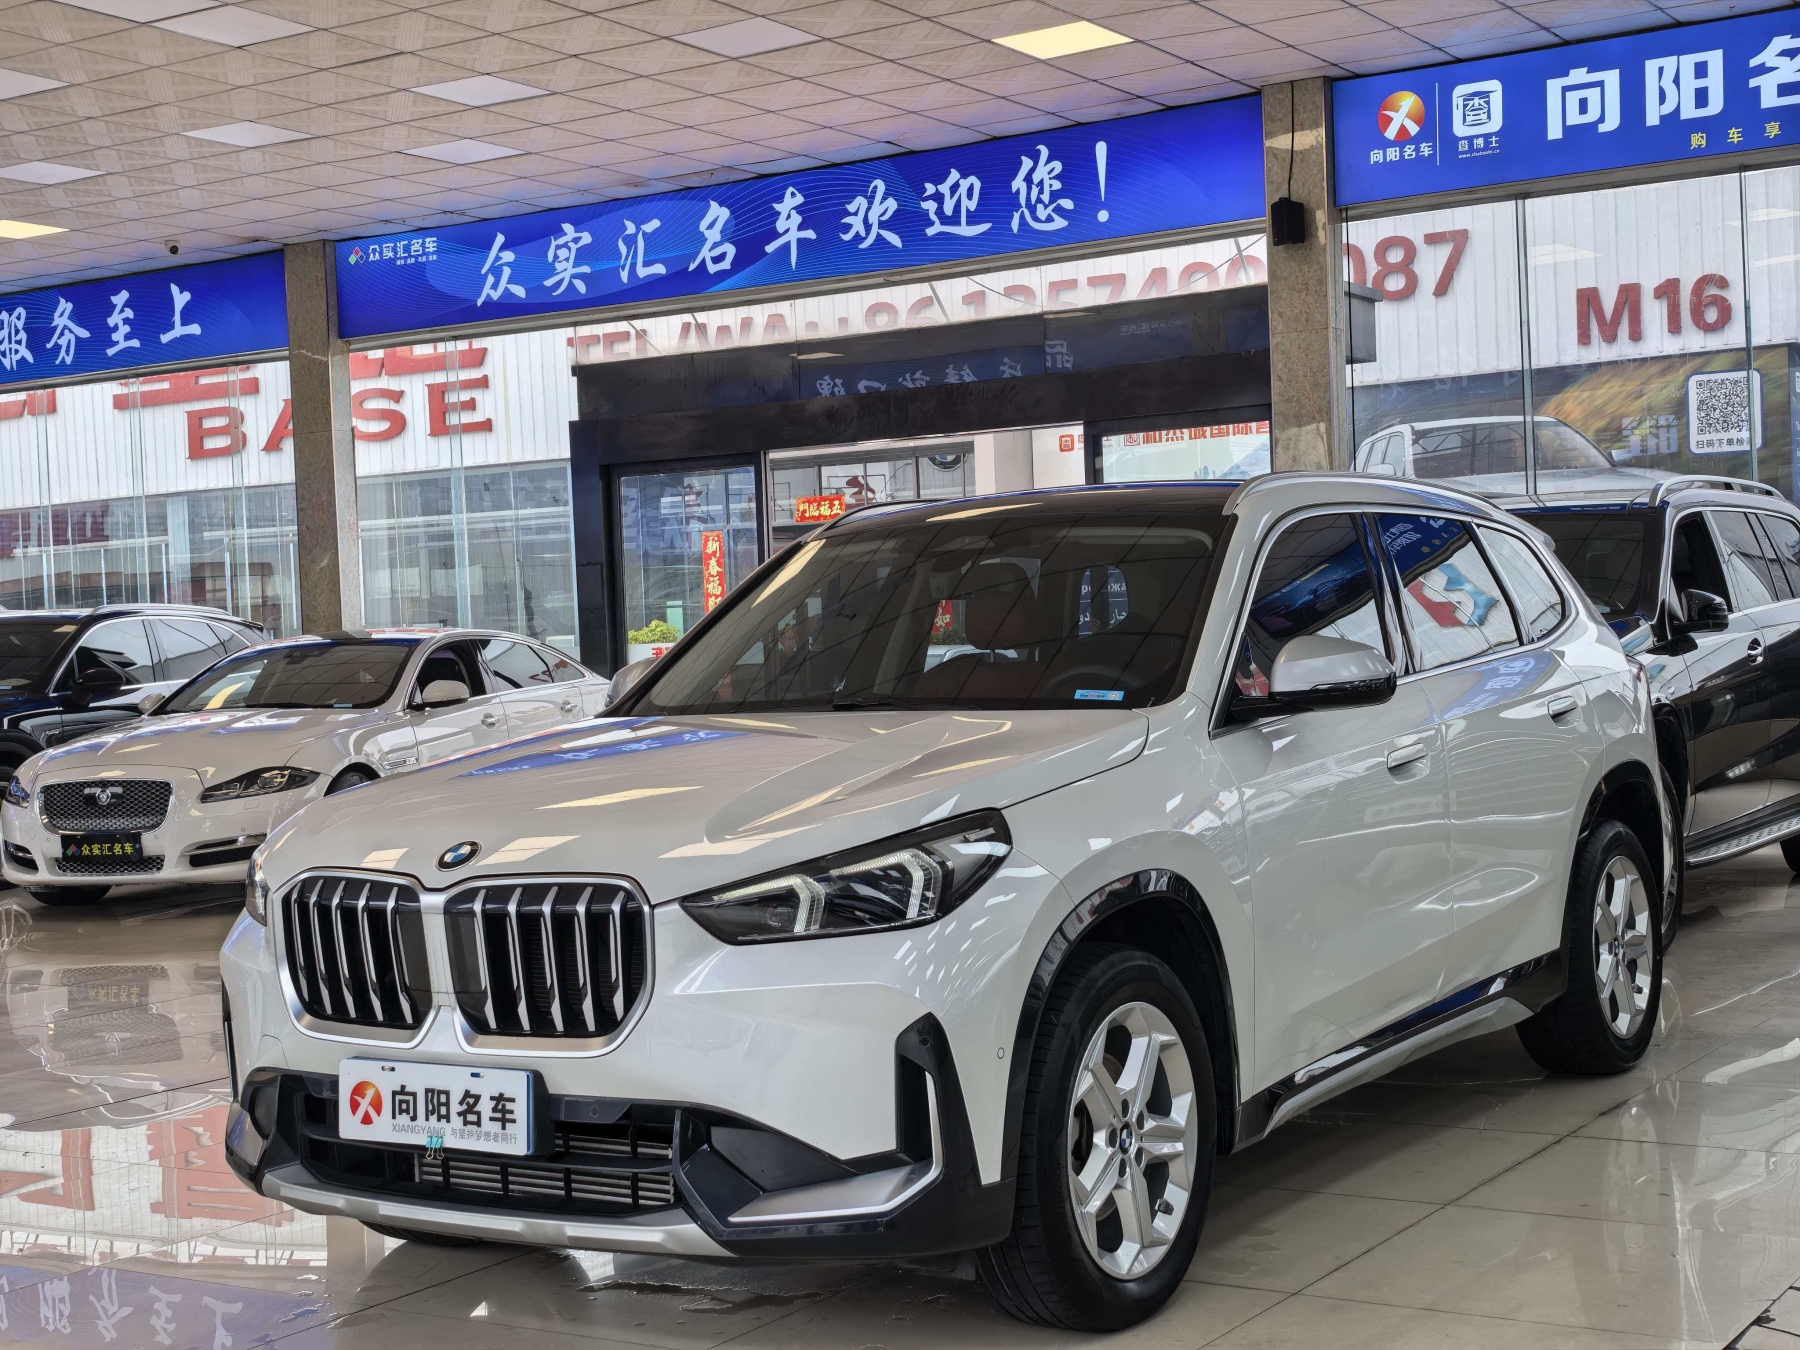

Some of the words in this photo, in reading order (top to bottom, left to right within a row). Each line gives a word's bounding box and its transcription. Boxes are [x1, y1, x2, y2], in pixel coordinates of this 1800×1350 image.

[1370, 142, 1434, 165] 向阳名车
[1458, 135, 1500, 152] 查博士
[368, 237, 437, 261] 众实汇名车
[1576, 273, 1732, 346] M16
[0, 283, 201, 371] 服务至上
[81, 843, 134, 856] 众实汇名车
[391, 1084, 517, 1131] 向阳名车
[392, 1123, 446, 1137] XIANGYANG
[450, 1127, 518, 1145] 与坚持梦想者同行
